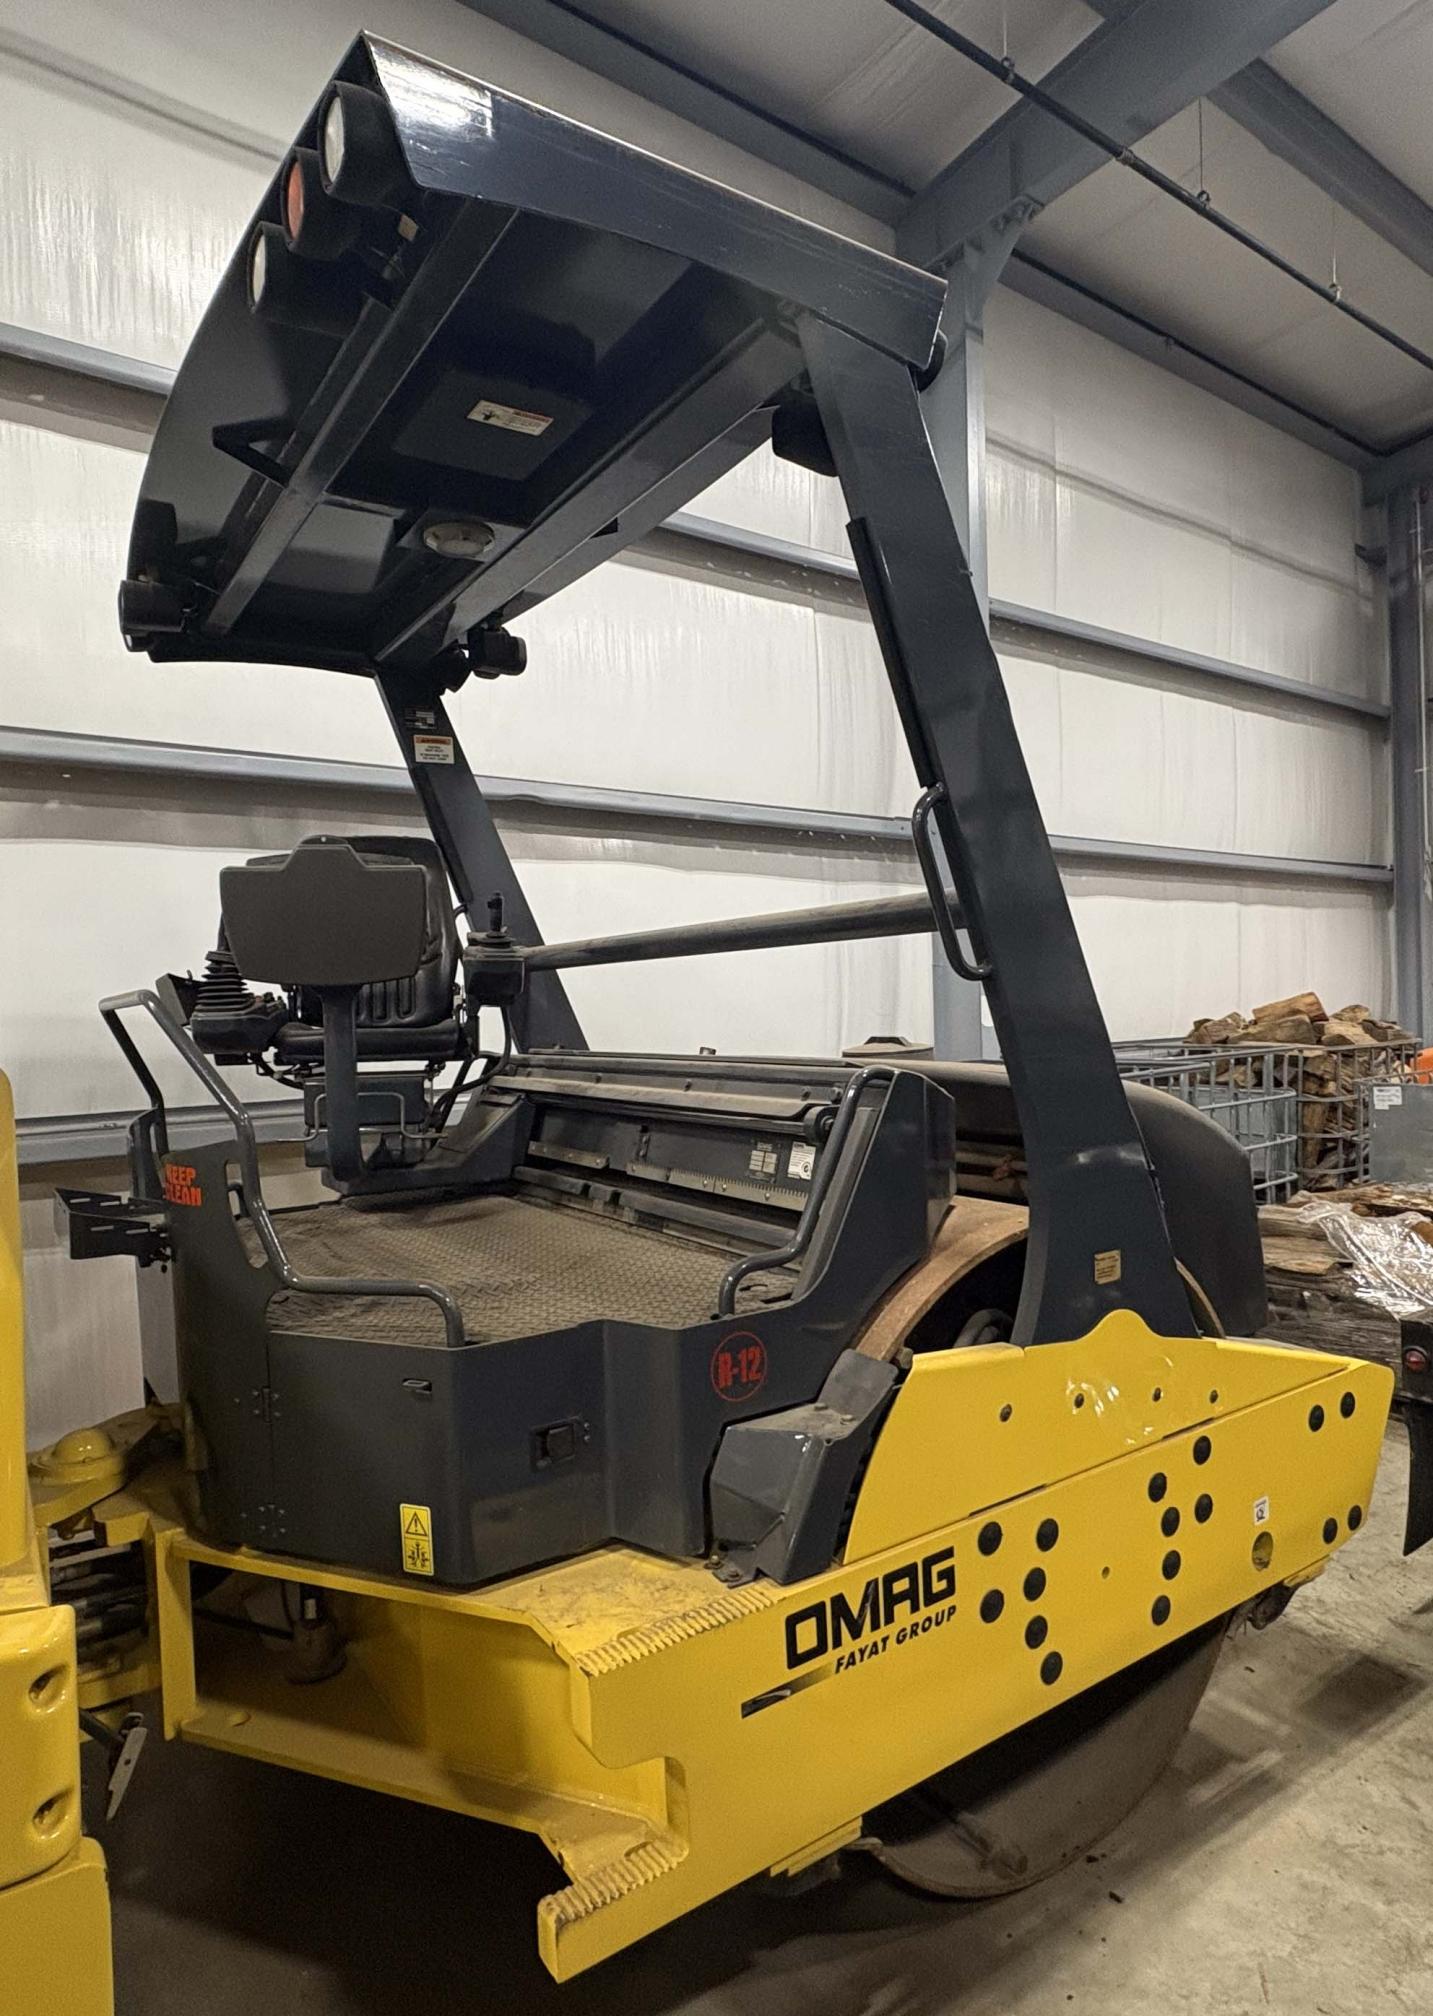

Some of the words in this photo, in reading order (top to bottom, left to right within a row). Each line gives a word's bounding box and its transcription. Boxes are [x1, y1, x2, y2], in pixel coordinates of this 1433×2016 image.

[785, 1545, 956, 1670] OMAG
[835, 1635, 890, 1674] FAYAT
[896, 1604, 957, 1645] GROUP
